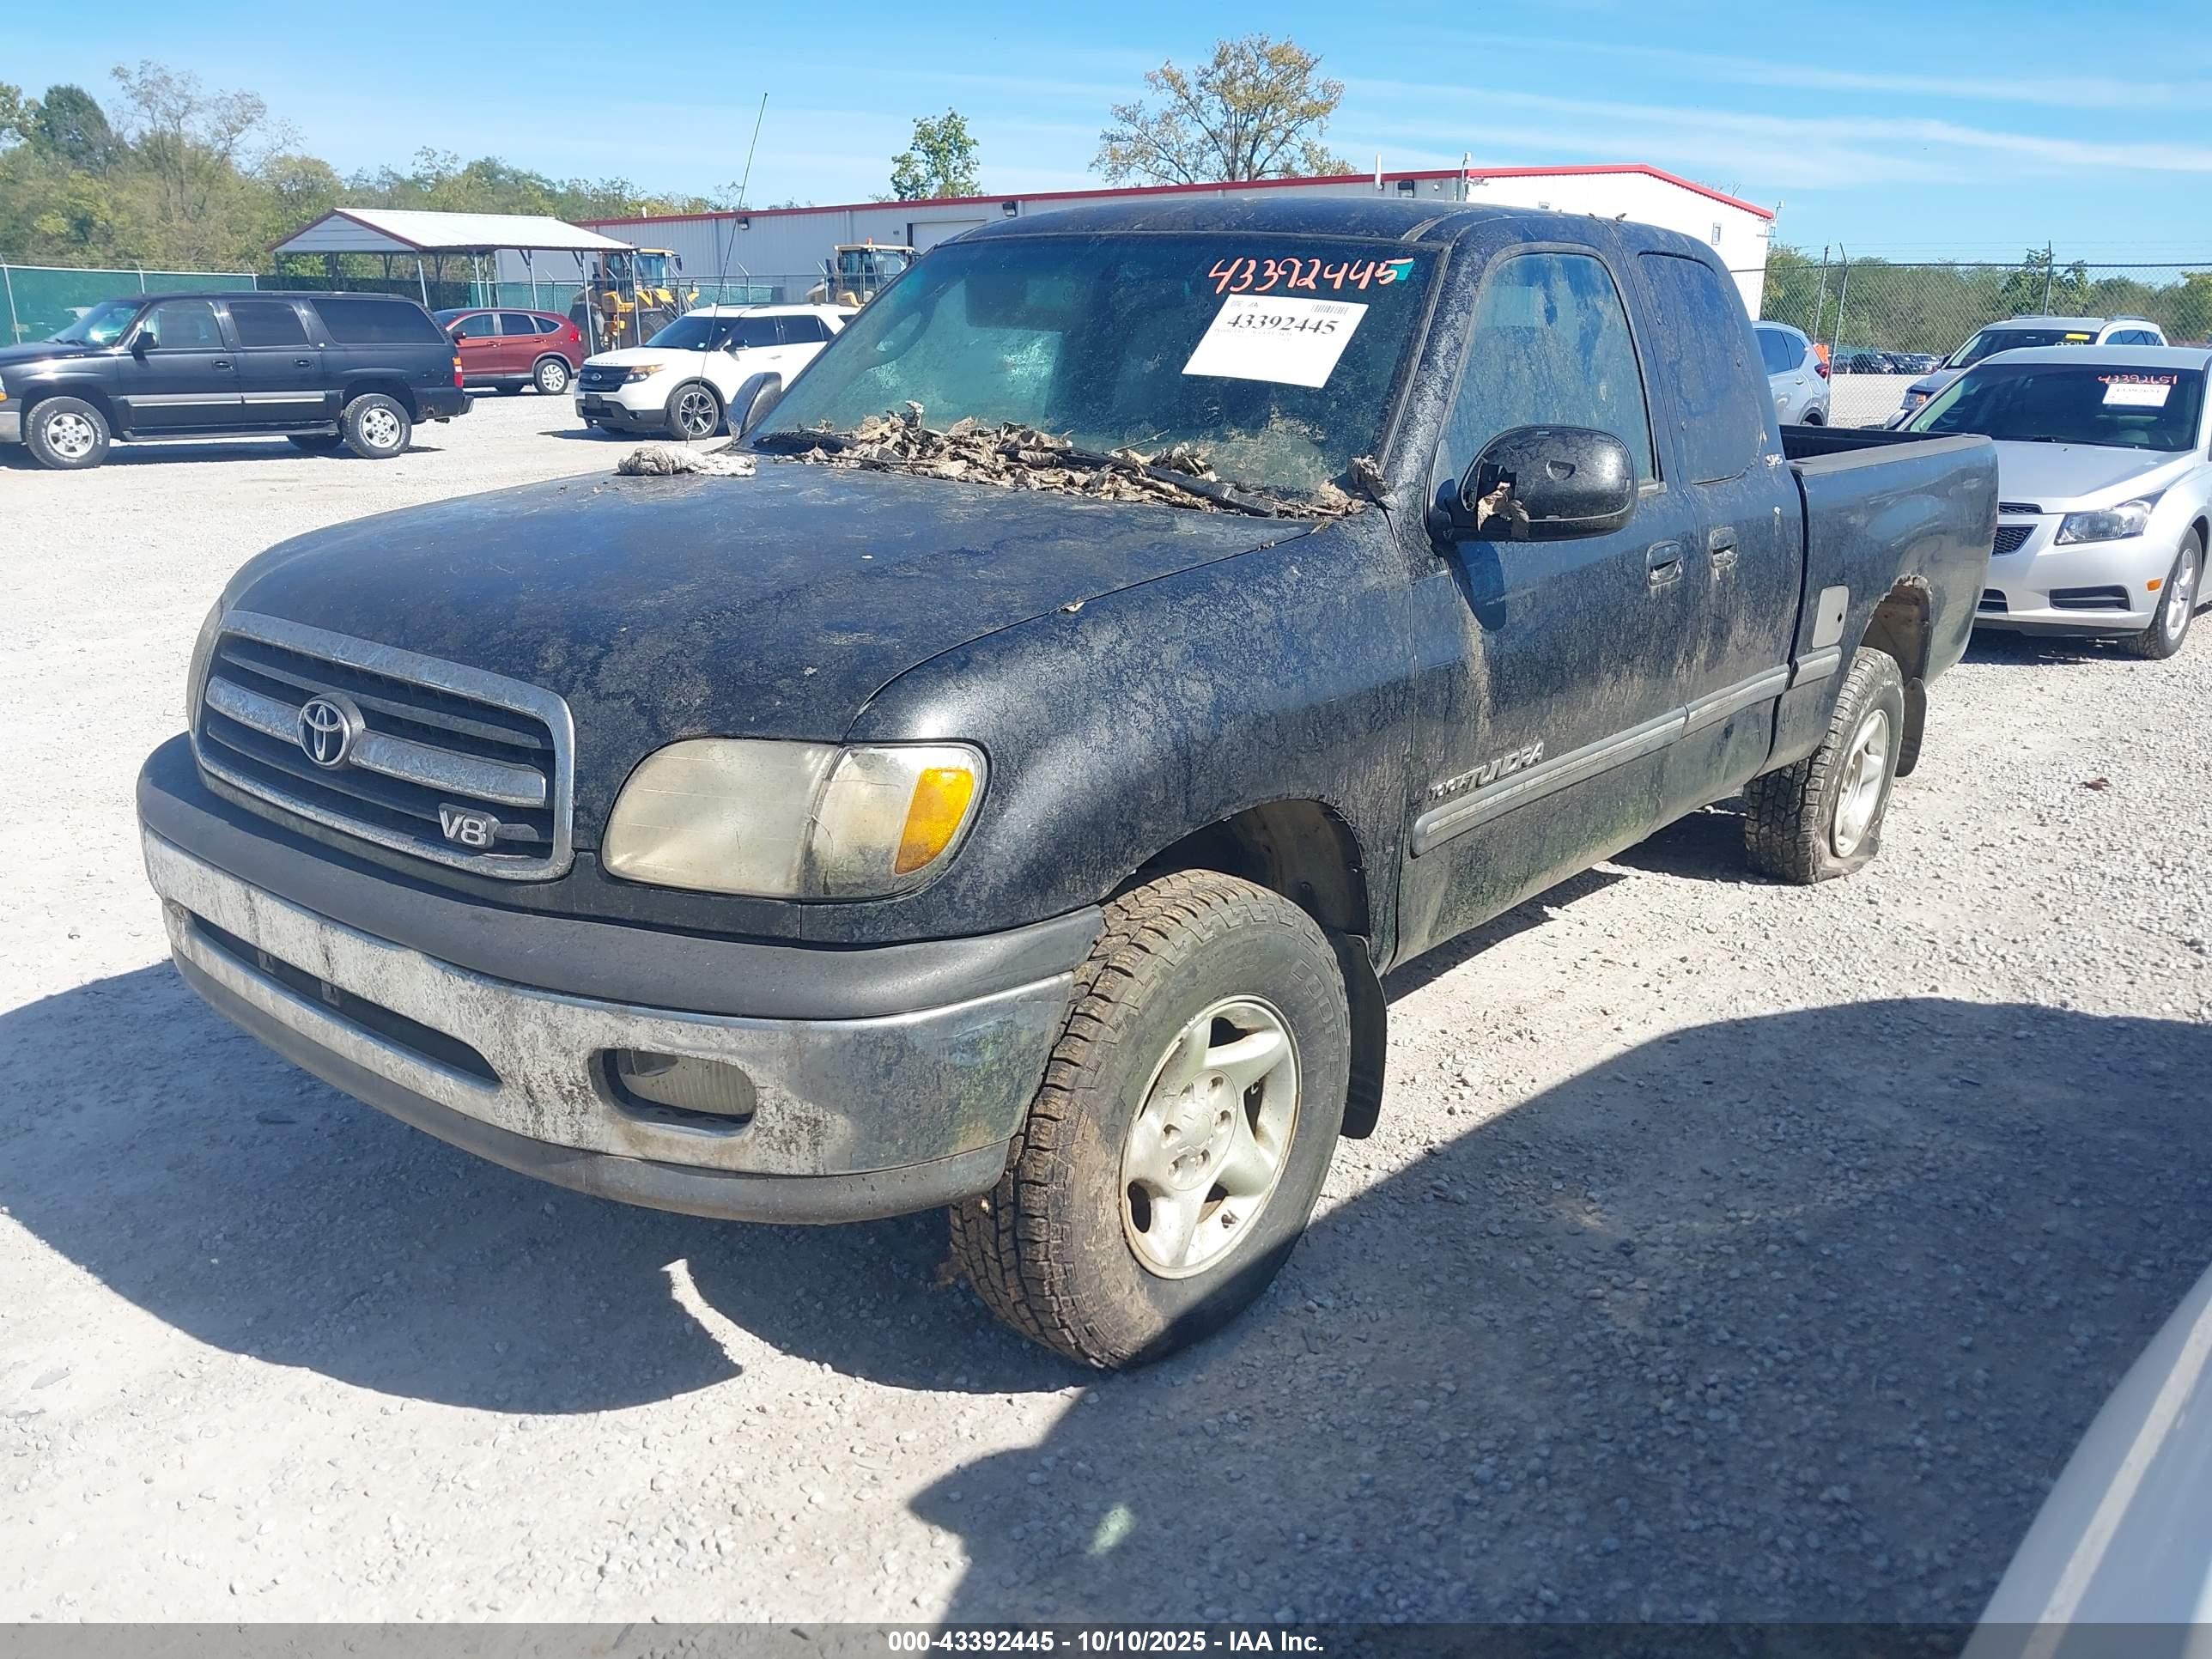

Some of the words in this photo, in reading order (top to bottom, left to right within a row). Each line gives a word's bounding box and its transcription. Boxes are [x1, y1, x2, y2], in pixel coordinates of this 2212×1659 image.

[1208, 257, 1414, 295] 43392445
[1227, 313, 1340, 336] 43392445
[2097, 374, 2179, 386] 43392651
[439, 810, 488, 846] V8
